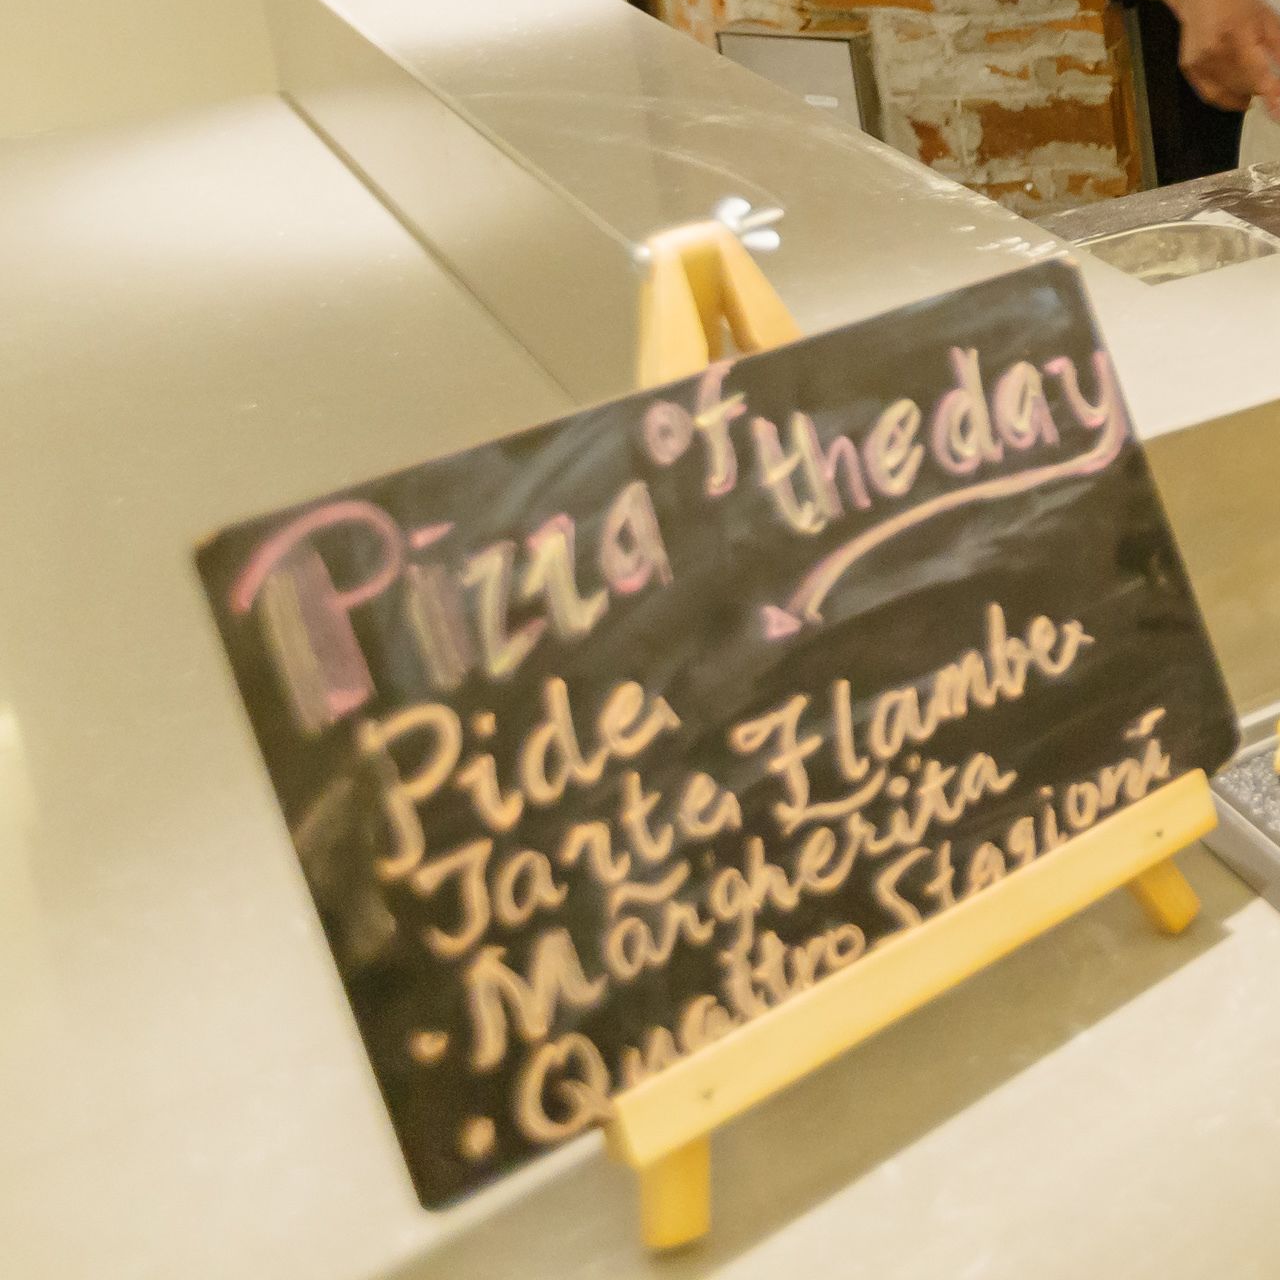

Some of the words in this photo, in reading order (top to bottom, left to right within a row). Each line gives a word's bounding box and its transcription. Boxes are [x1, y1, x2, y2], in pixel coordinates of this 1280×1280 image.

[228, 499, 675, 739] Pizza
[643, 359, 748, 498] of
[752, 398, 925, 536] the
[932, 346, 1128, 475] day
[468, 752, 1019, 1072] Margherita
